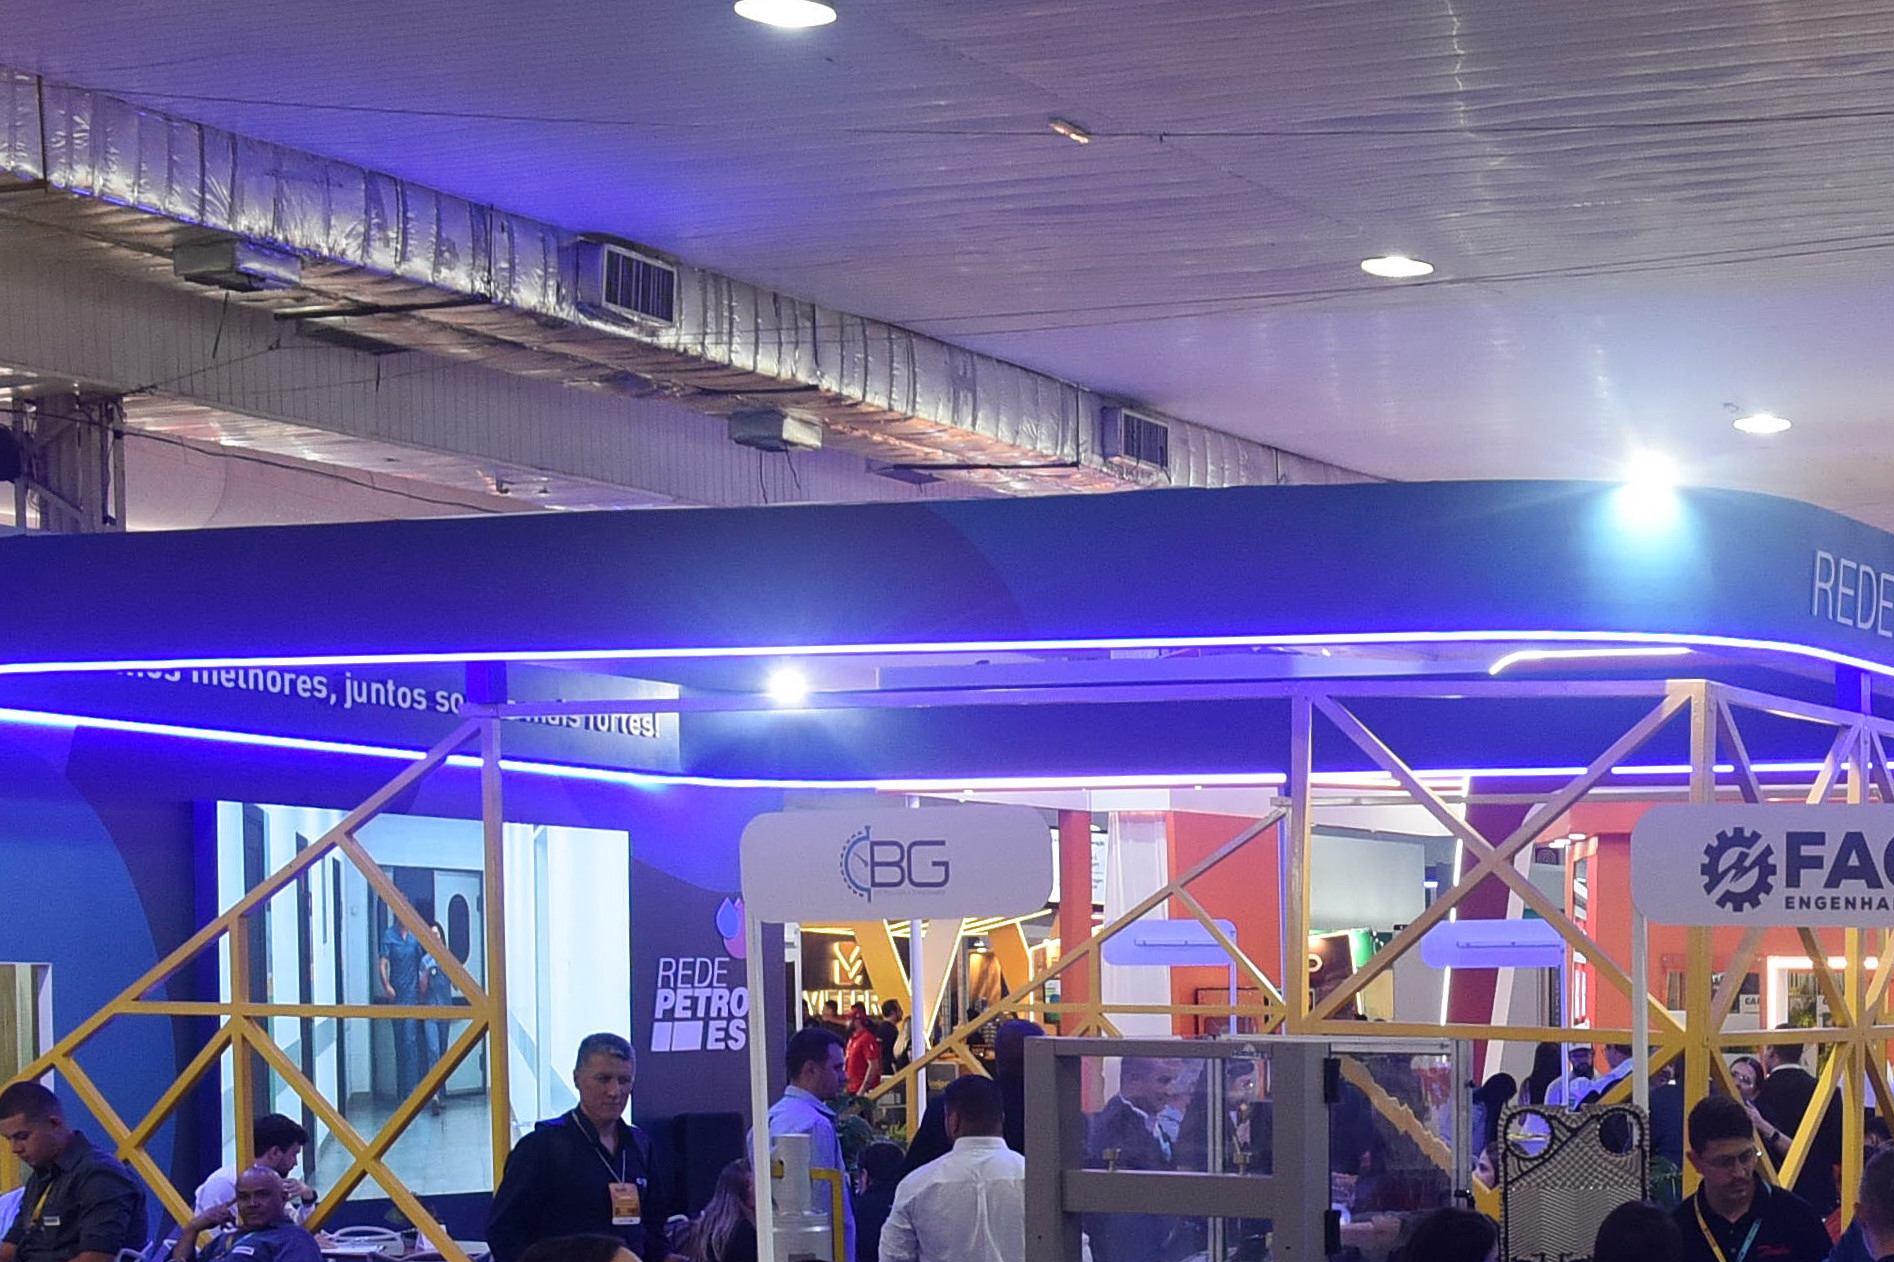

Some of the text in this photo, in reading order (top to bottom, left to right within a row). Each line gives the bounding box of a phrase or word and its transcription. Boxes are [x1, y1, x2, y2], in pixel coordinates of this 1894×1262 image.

[342, 671, 428, 710] juntos
[656, 956, 731, 989] REDE
[654, 986, 749, 1019] PETRO
[706, 1018, 747, 1051] ES
